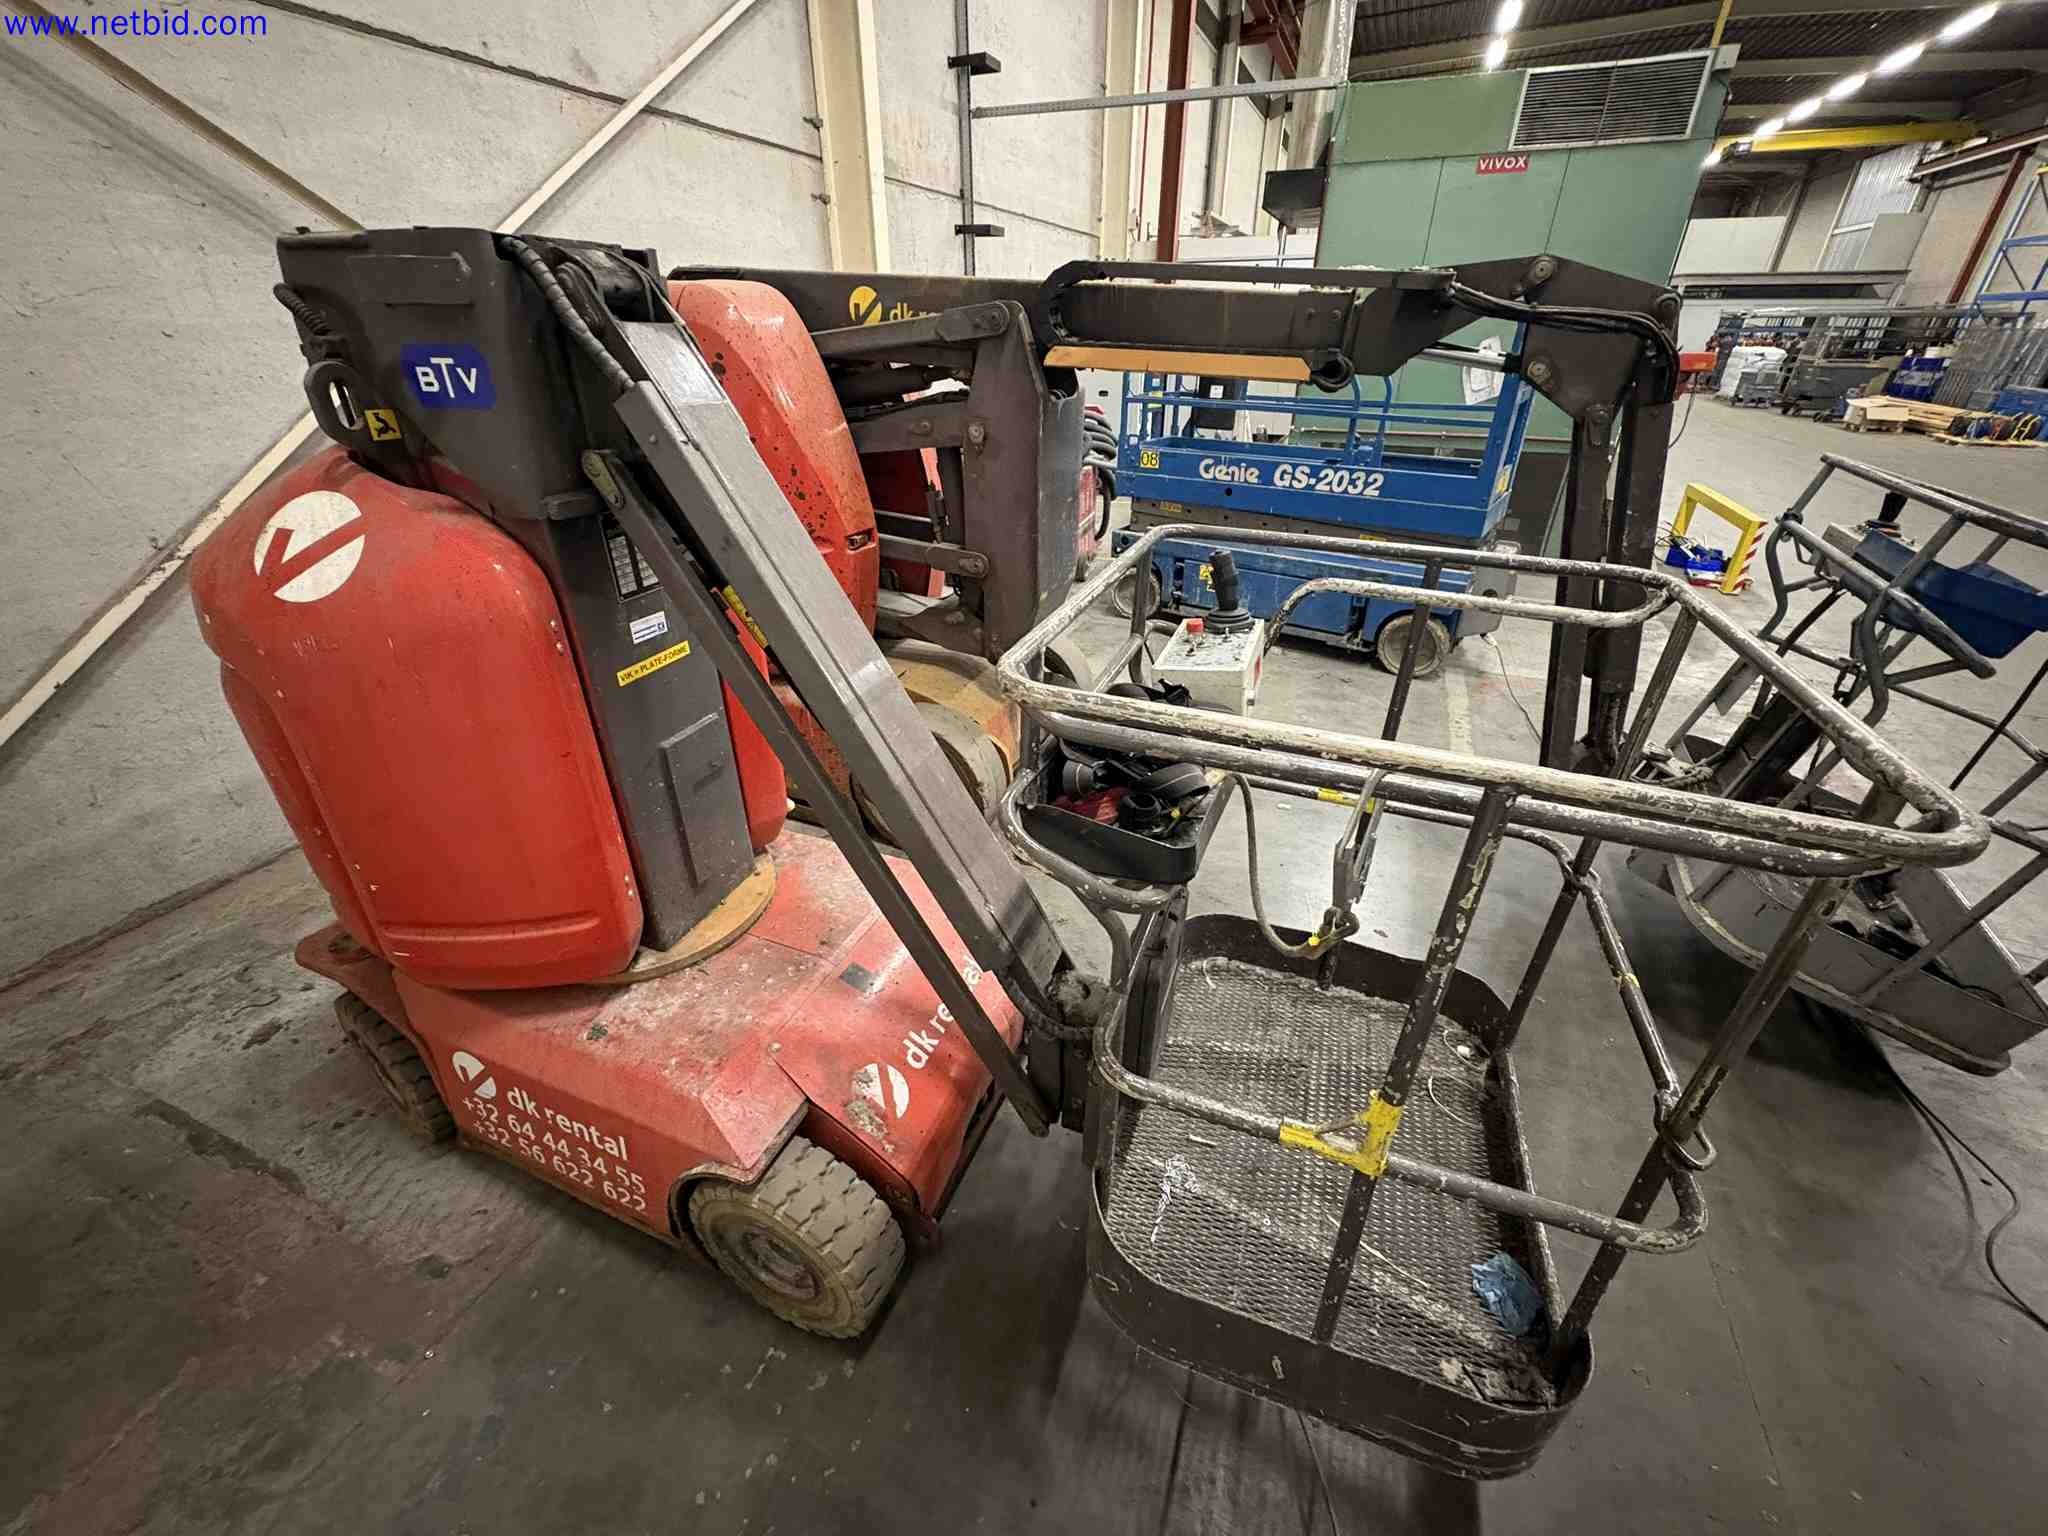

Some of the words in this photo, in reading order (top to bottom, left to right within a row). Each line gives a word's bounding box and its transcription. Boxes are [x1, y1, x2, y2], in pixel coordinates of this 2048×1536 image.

[1480, 155, 1527, 170] VIVOX
[415, 357, 477, 398] BTV
[1141, 451, 1159, 467] 08
[1199, 458, 1260, 484] Genie
[1273, 464, 1385, 497] GS-2032
[902, 1029, 940, 1070] dk
[506, 1086, 541, 1119] dk
[545, 1107, 629, 1162] rental
[462, 1097, 499, 1124] +32
[507, 1113, 536, 1141] 64
[543, 1132, 571, 1158] 44
[576, 1147, 609, 1175] 34
[615, 1166, 647, 1195] 55
[473, 1120, 512, 1148] +32
[518, 1137, 545, 1165] 56
[552, 1156, 596, 1189] 622
[602, 1180, 648, 1214] 622
